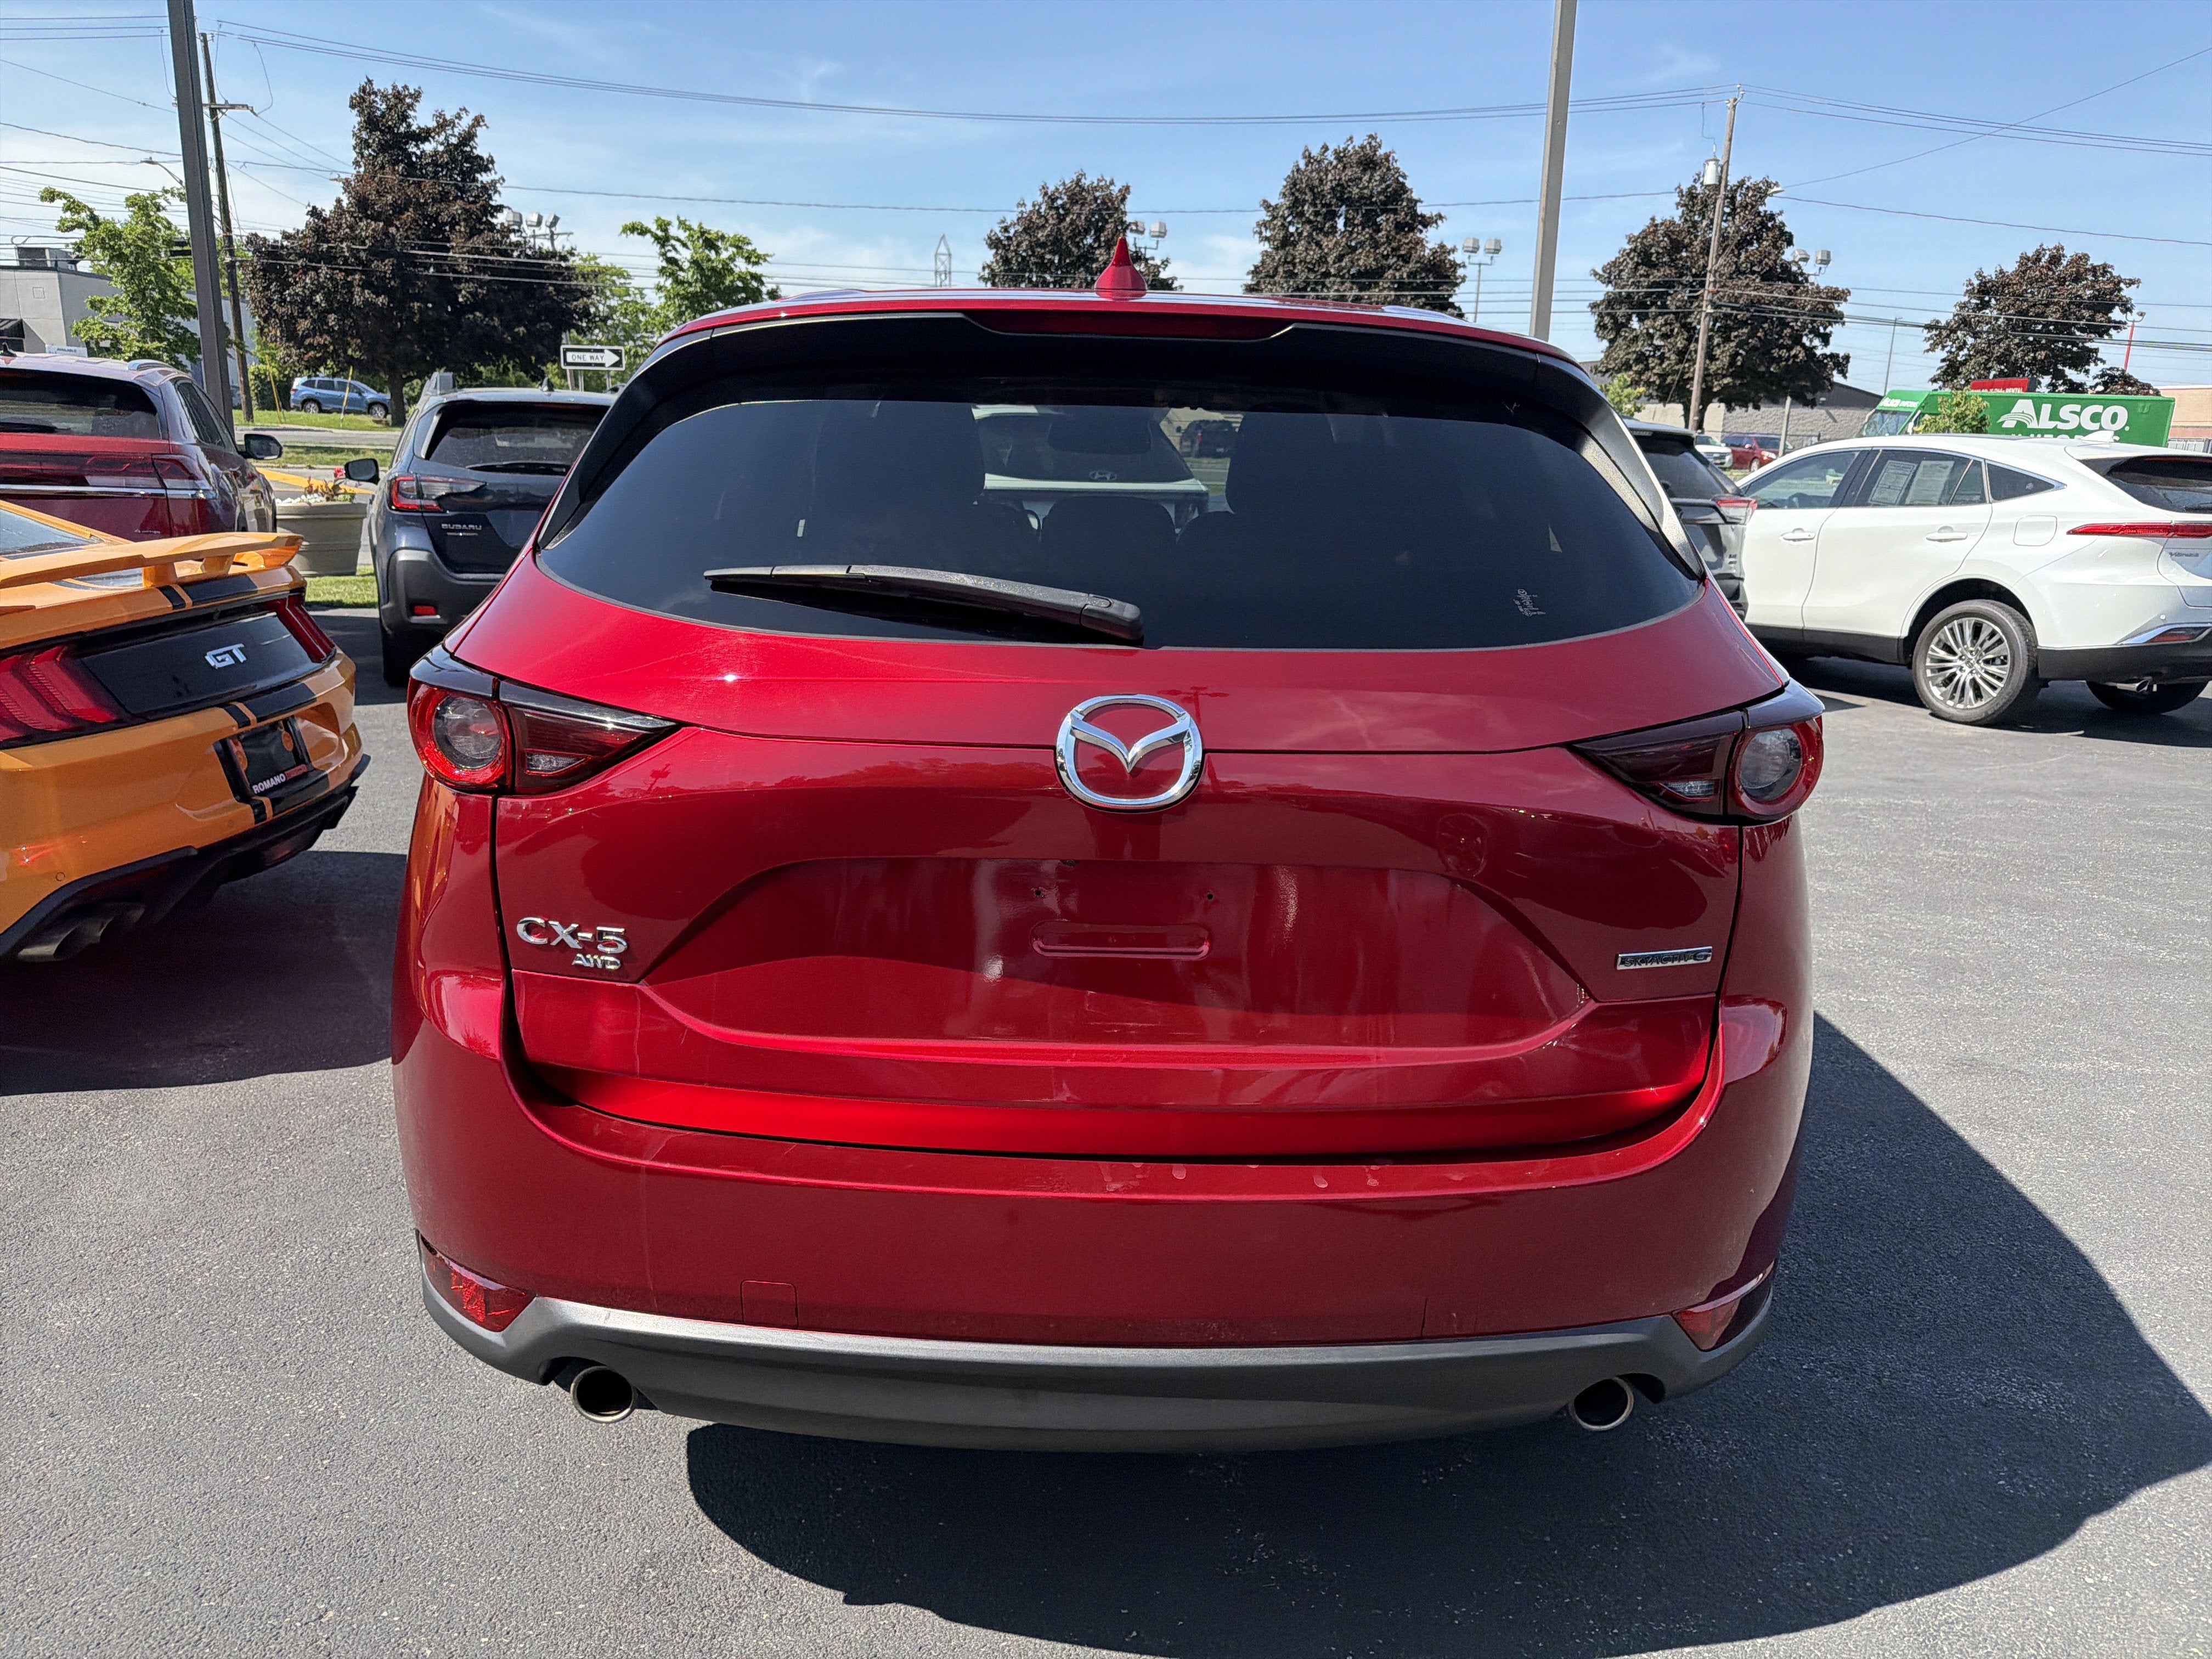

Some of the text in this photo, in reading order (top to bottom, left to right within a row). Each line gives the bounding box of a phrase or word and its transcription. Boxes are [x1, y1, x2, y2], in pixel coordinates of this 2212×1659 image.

[1996, 399, 2129, 431] ALSCO
[205, 643, 247, 669] GT
[252, 773, 286, 794] ROMANO
[516, 916, 628, 953] CX-5
[571, 953, 622, 970] AWD
